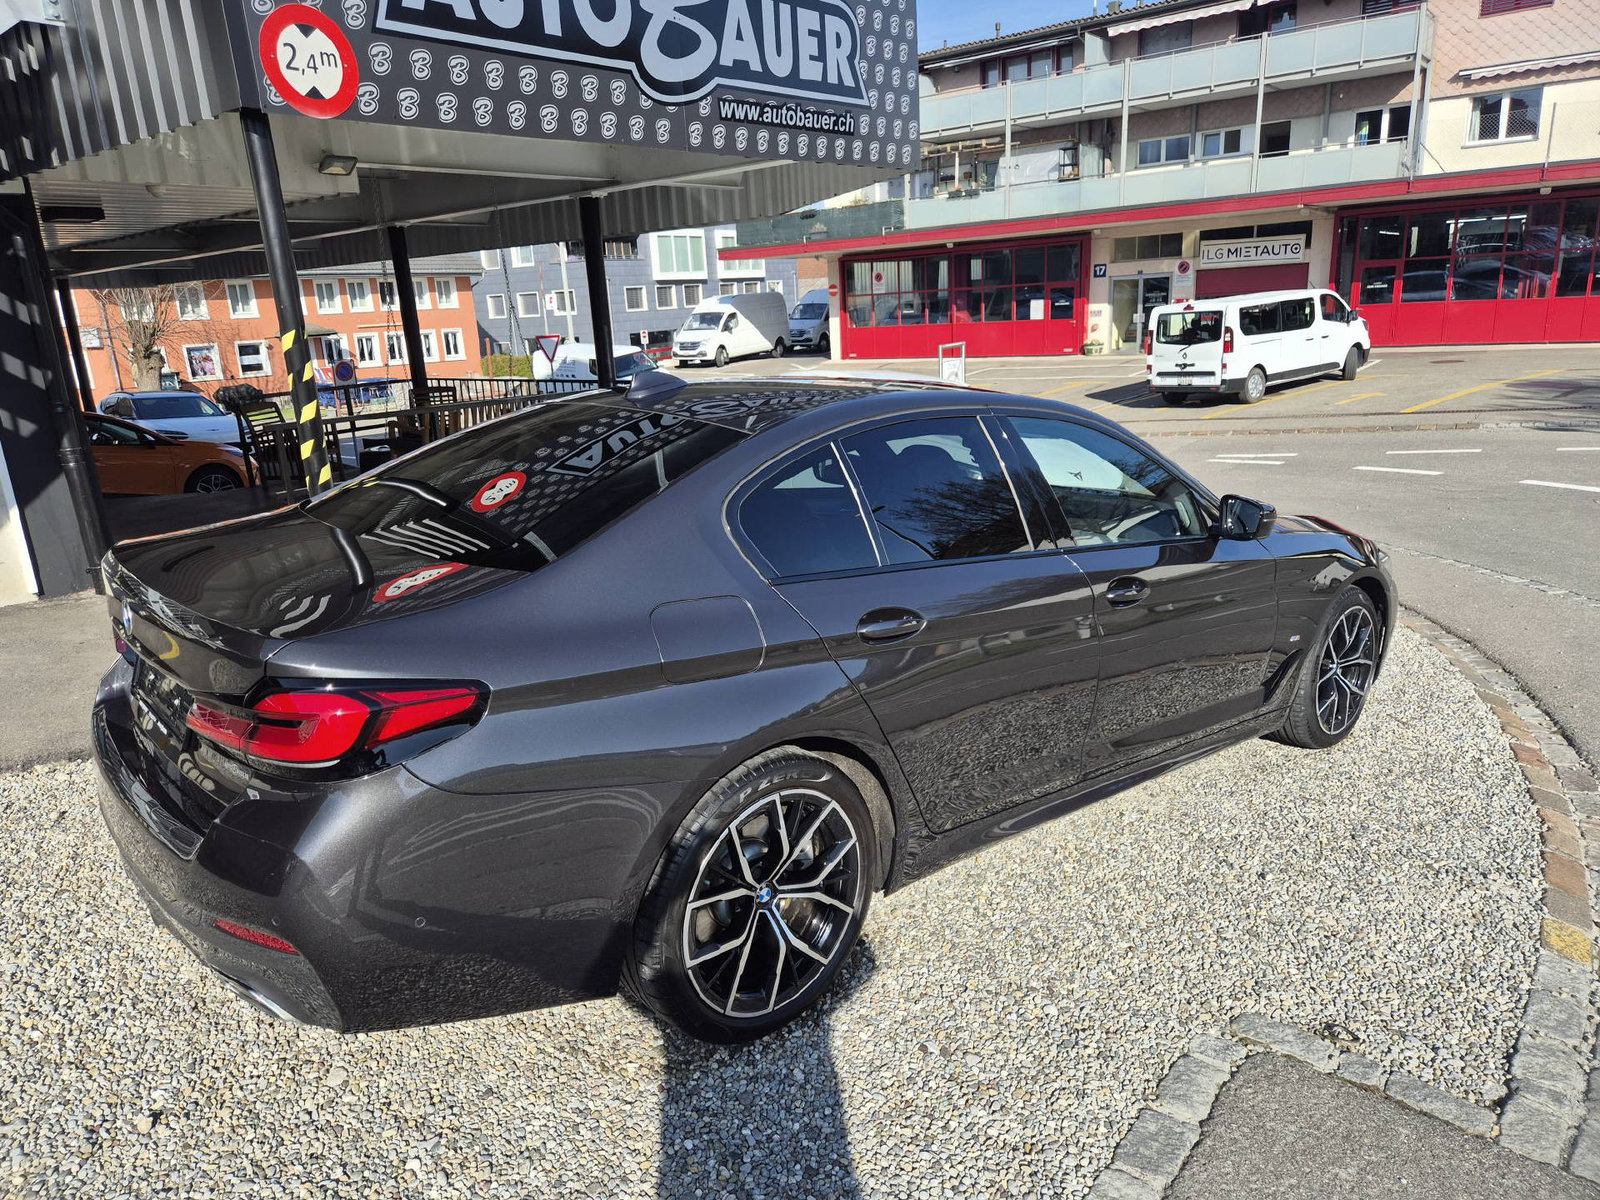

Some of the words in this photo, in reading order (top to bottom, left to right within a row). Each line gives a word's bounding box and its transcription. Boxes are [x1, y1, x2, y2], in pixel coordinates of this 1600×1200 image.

[719, 100, 855, 132] www.autobauer.ch
[1202, 248, 1223, 260] ILG
[1227, 243, 1301, 259] MIETAUTO
[1095, 265, 1106, 276] 17
